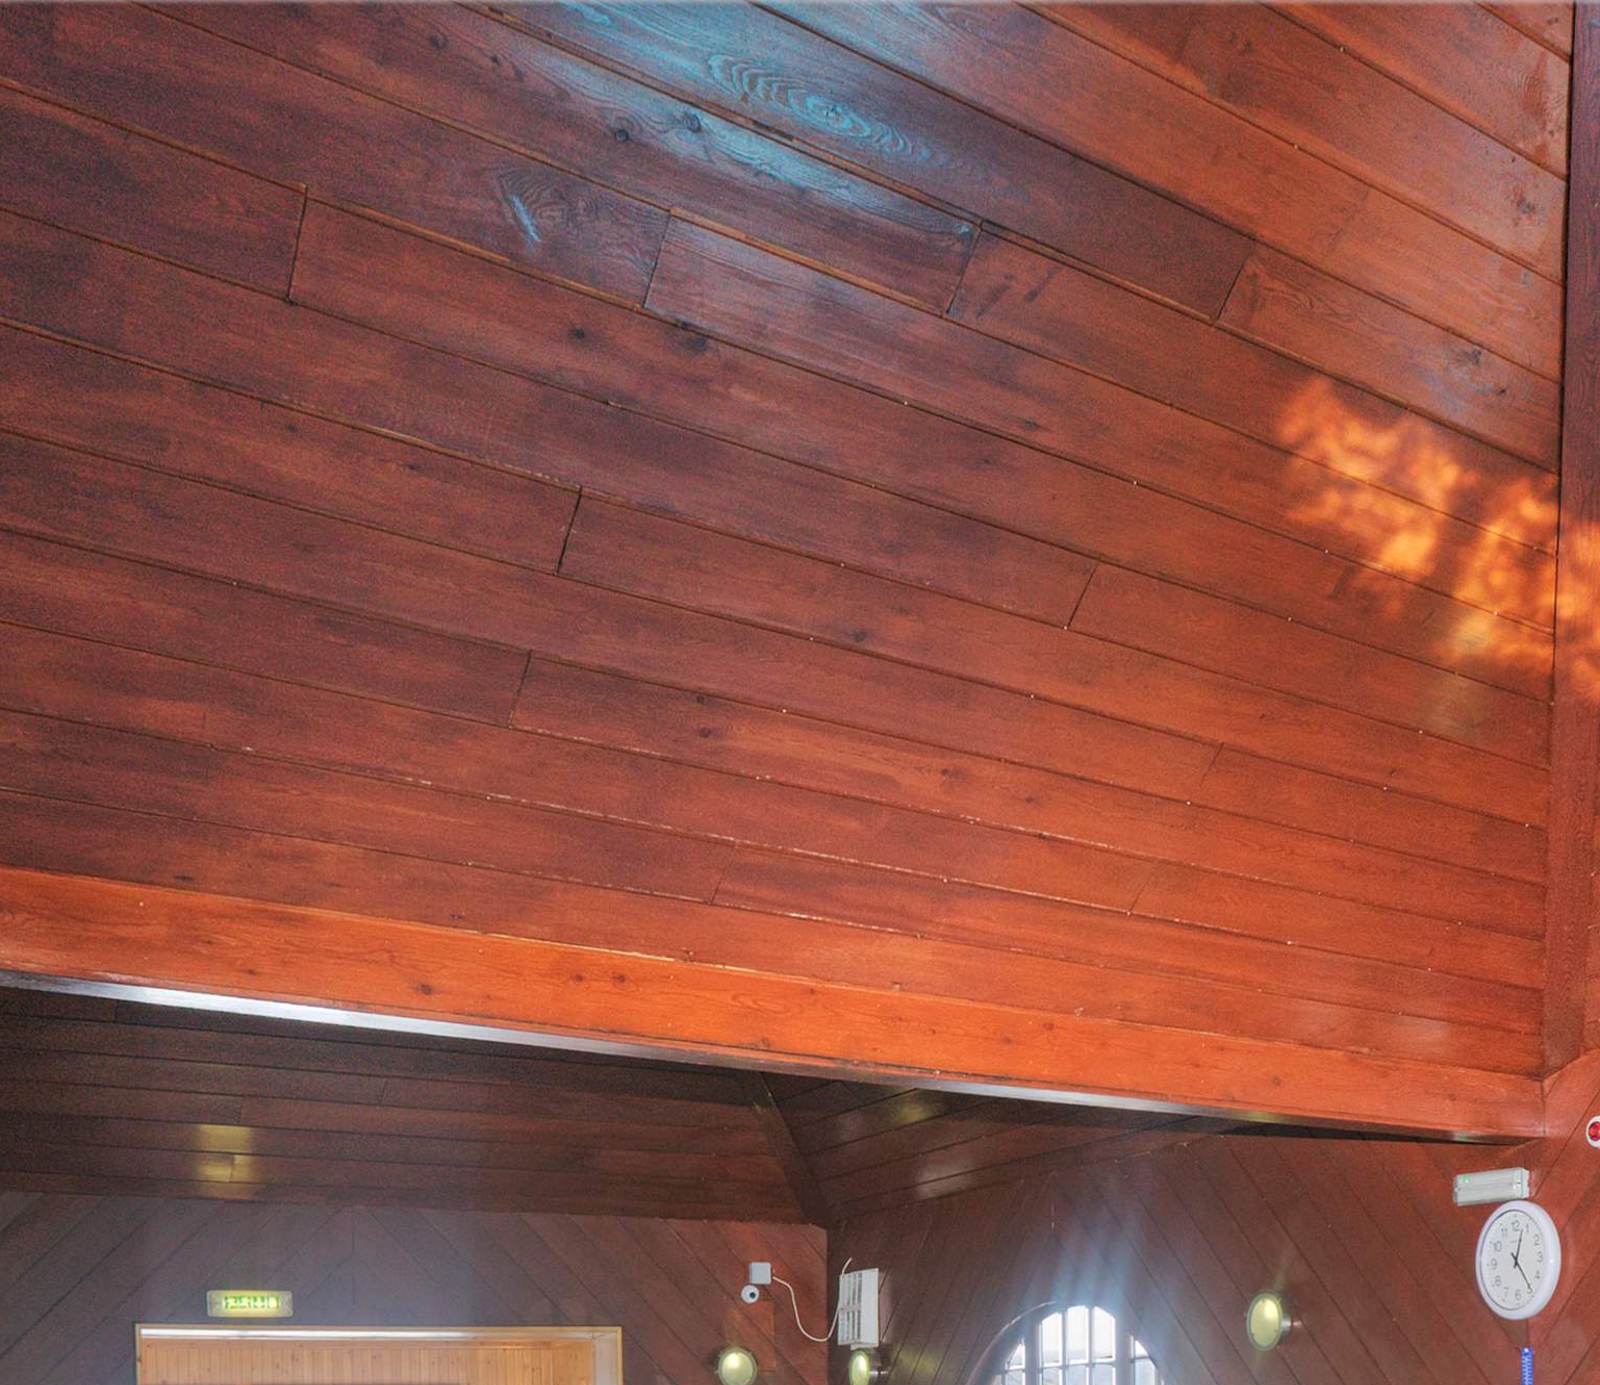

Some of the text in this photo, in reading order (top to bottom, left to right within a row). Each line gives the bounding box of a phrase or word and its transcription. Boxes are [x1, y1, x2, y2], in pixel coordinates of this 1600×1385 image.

[1511, 1219, 1520, 1232] 12
[1493, 1239, 1502, 1252] 10
[1533, 1233, 1540, 1246] 2
[1537, 1250, 1543, 1263] 3
[1490, 1257, 1498, 1270] 9
[1494, 1274, 1502, 1287] 8
[1514, 1288, 1521, 1301] 6
